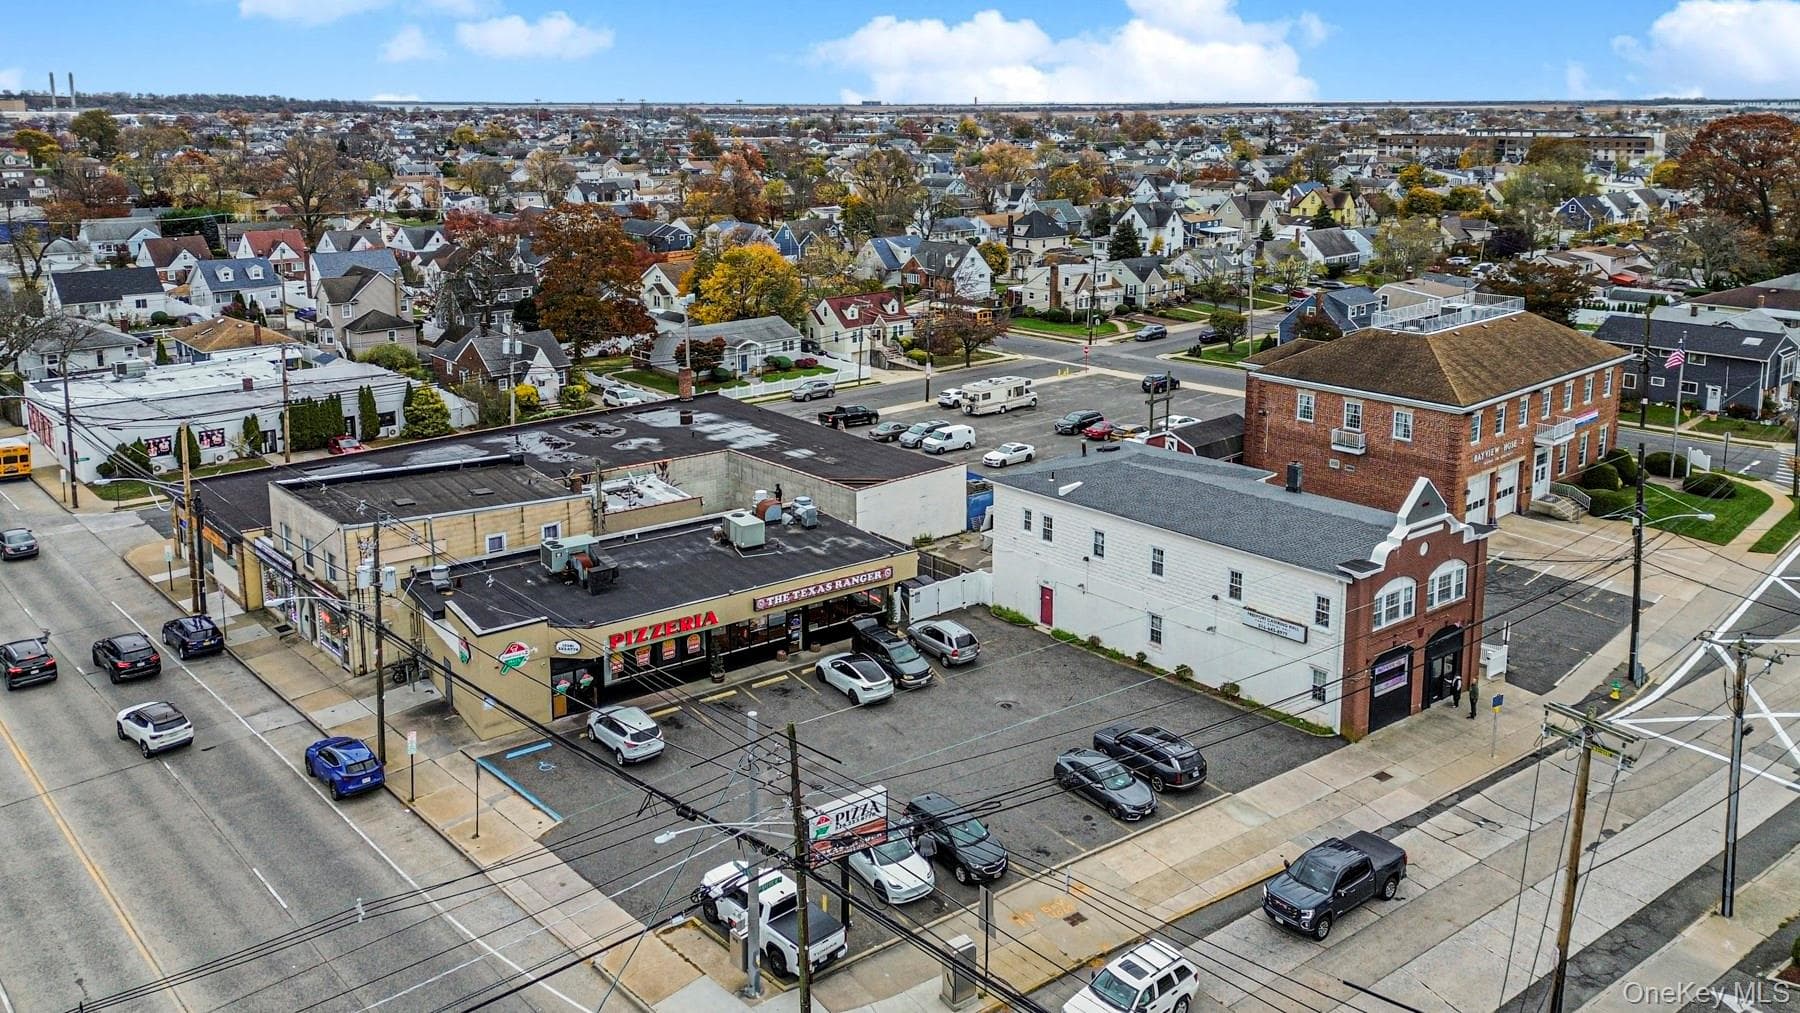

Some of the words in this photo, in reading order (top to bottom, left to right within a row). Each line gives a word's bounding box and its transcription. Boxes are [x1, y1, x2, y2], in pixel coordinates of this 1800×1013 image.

[1473, 446, 1500, 463] BAYVIEW
[1503, 439, 1518, 452] HOSE
[766, 593, 790, 606] THE
[792, 582, 833, 600] TEXAS
[834, 570, 882, 589] RANGER
[609, 610, 718, 649] PIZZERIA
[835, 799, 881, 823] PIZZA
